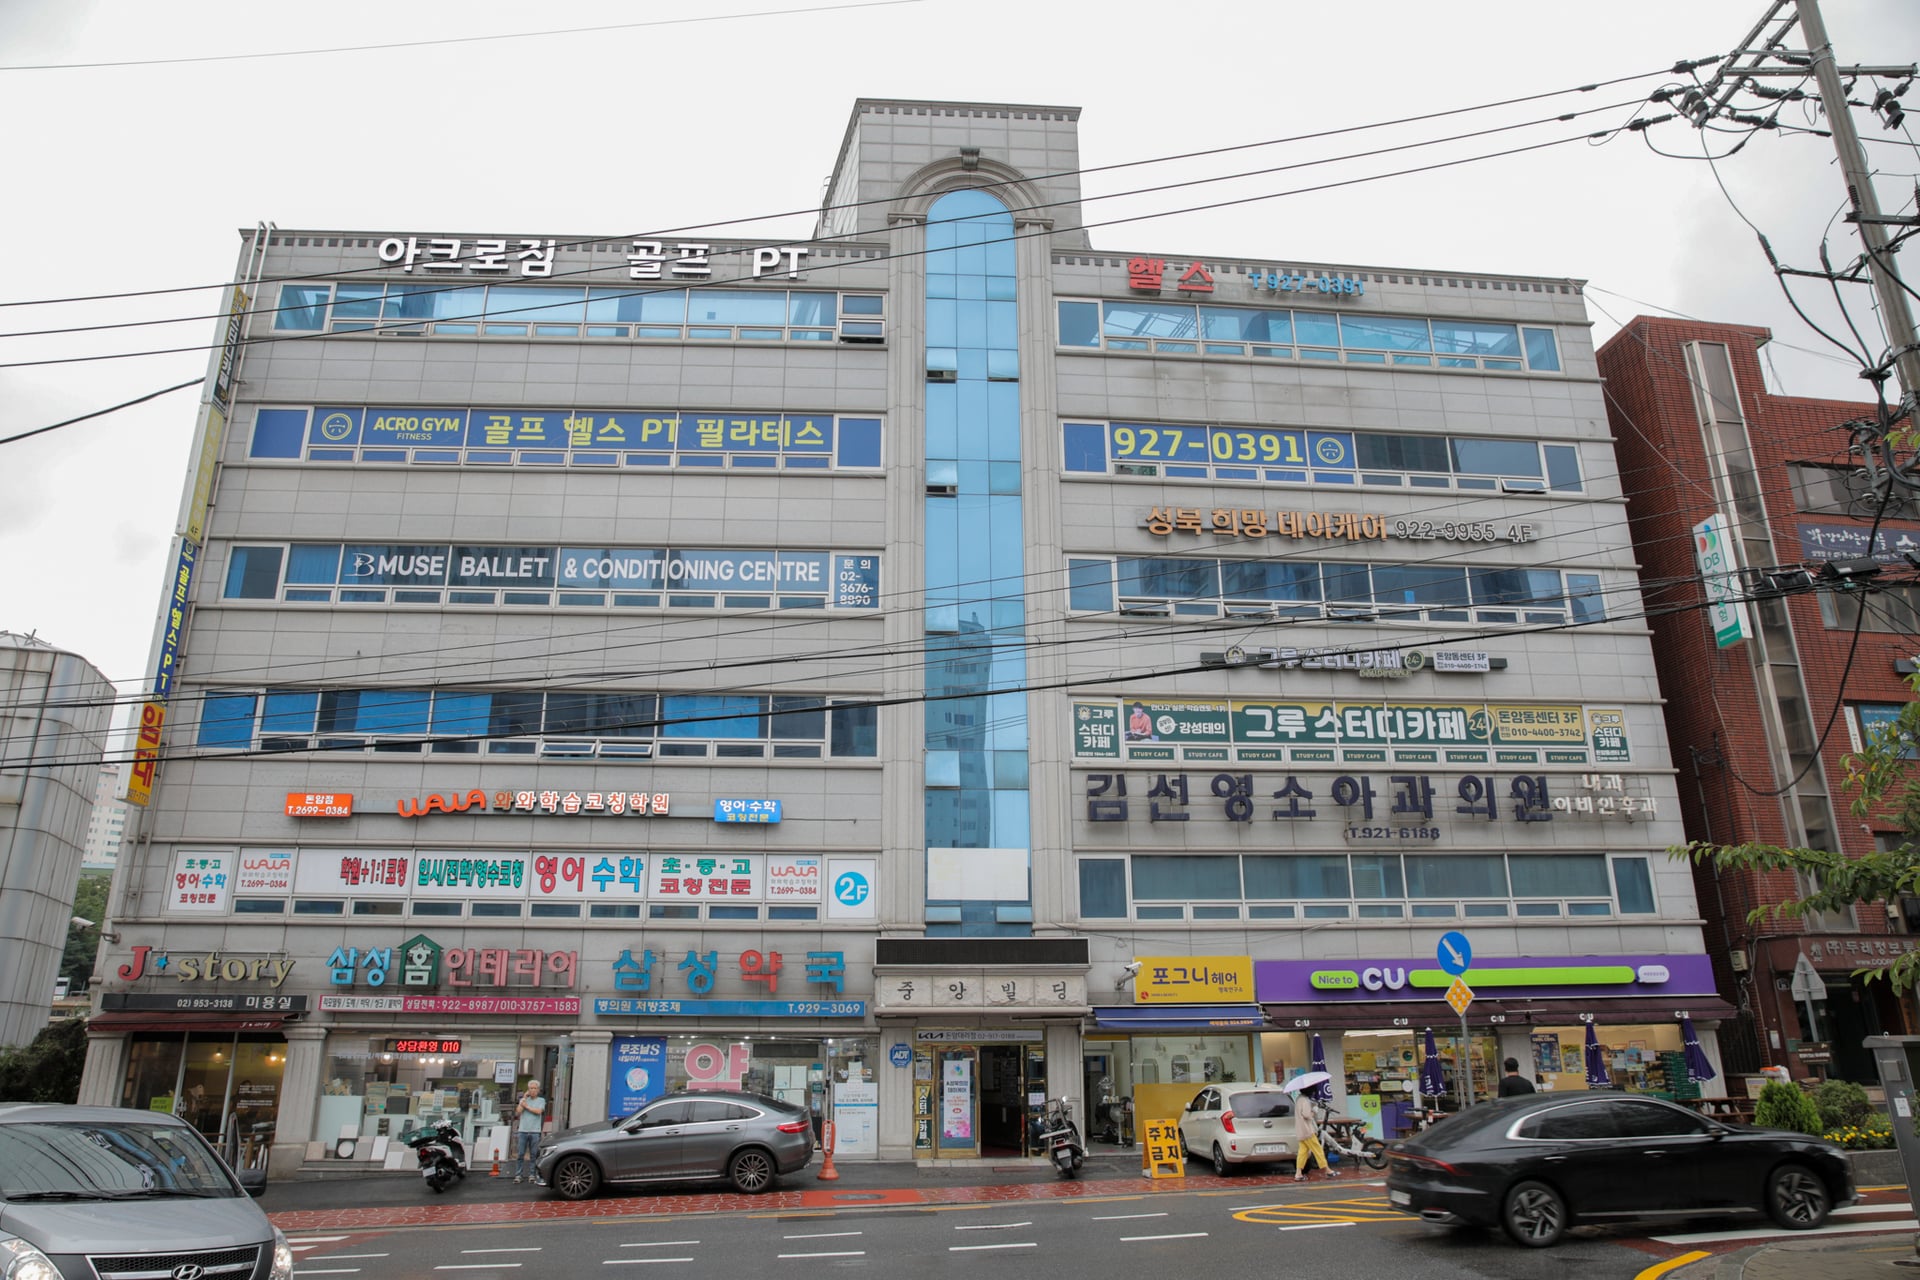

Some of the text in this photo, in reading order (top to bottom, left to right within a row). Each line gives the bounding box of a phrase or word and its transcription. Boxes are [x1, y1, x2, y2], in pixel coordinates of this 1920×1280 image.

[378, 236, 808, 279] 아크로짐 골프 PT
[1127, 257, 1214, 293] 헬스
[373, 416, 460, 432] ACRO GYM
[484, 415, 825, 448] 골프 헬스 PT 필라테스
[396, 432, 432, 441] FITNESS
[1113, 427, 1304, 463] 927-0391
[1146, 506, 1533, 543] 성북 희망 데이케어 922-9955 4F
[377, 555, 446, 577] MUSE
[459, 556, 549, 578] BALLET
[564, 561, 578, 579] &
[582, 559, 735, 581] CONDITIONING
[738, 560, 820, 582] CENTRE
[1704, 552, 1721, 570] DB
[840, 571, 861, 581] 02-
[840, 583, 874, 593] 3676-
[1092, 709, 1114, 719] 그루
[1498, 711, 1578, 724] 돈암동센터 3F
[1078, 723, 1115, 736] 스터디
[1245, 709, 1467, 741] 그루 스터디카페
[1511, 728, 1582, 737] 010-4400-3742
[1083, 736, 1111, 749] 카페
[1087, 774, 1553, 824] 김선영소아과의원
[1554, 796, 1658, 815] 이비인후과
[288, 806, 348, 815] T.2699-0384
[535, 855, 644, 894] 영어 수학
[241, 880, 288, 888] T.2699-0384
[770, 886, 817, 895] T.2699-0384
[839, 877, 868, 901] 2F
[118, 946, 296, 988] J story
[326, 945, 578, 988] 삼성 홈 인테리어
[1318, 967, 1406, 991] Nice to CU
[193, 999, 233, 1009] 953-3138
[246, 996, 292, 1009] 미용실
[598, 1000, 681, 1013] 병의원 처방조제
[787, 1003, 861, 1014] T.929-3069
[442, 1041, 460, 1053] 010
[1148, 1126, 1177, 1141] 주차
[1151, 1145, 1179, 1161] 금지
